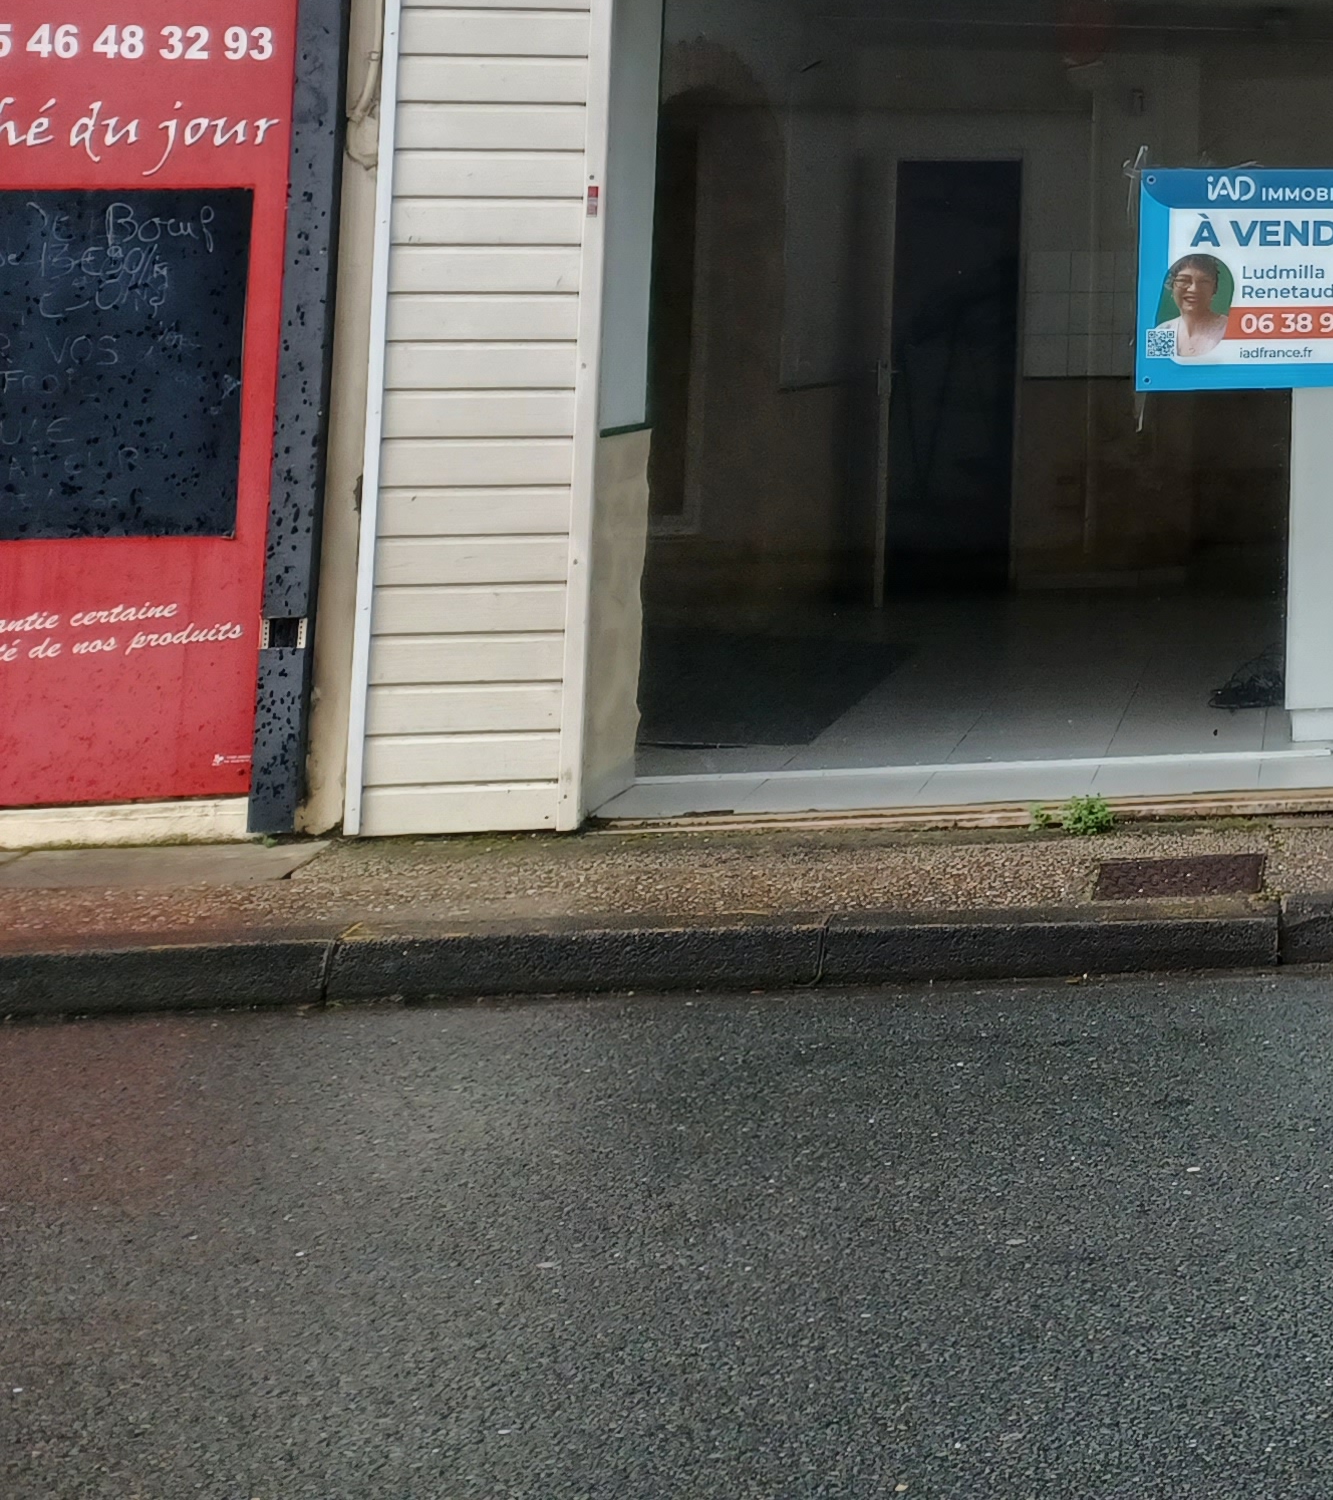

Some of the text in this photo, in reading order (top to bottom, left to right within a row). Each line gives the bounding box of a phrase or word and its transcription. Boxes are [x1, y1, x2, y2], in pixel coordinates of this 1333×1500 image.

[26, 23, 79, 59] 46
[93, 25, 144, 59] 48
[159, 25, 209, 60] 32
[224, 27, 273, 60] 93
[69, 101, 139, 162] du
[142, 101, 279, 176] jour
[1190, 213, 1221, 247] À
[1242, 265, 1325, 280] Ludmilla
[1240, 313, 1274, 334] 06
[1280, 312, 1313, 333] 38
[1239, 347, 1313, 359] iadfrance.fr
[70, 602, 178, 628] certaine
[28, 637, 62, 659] de
[72, 636, 118, 655] nos
[125, 621, 243, 655] produits
